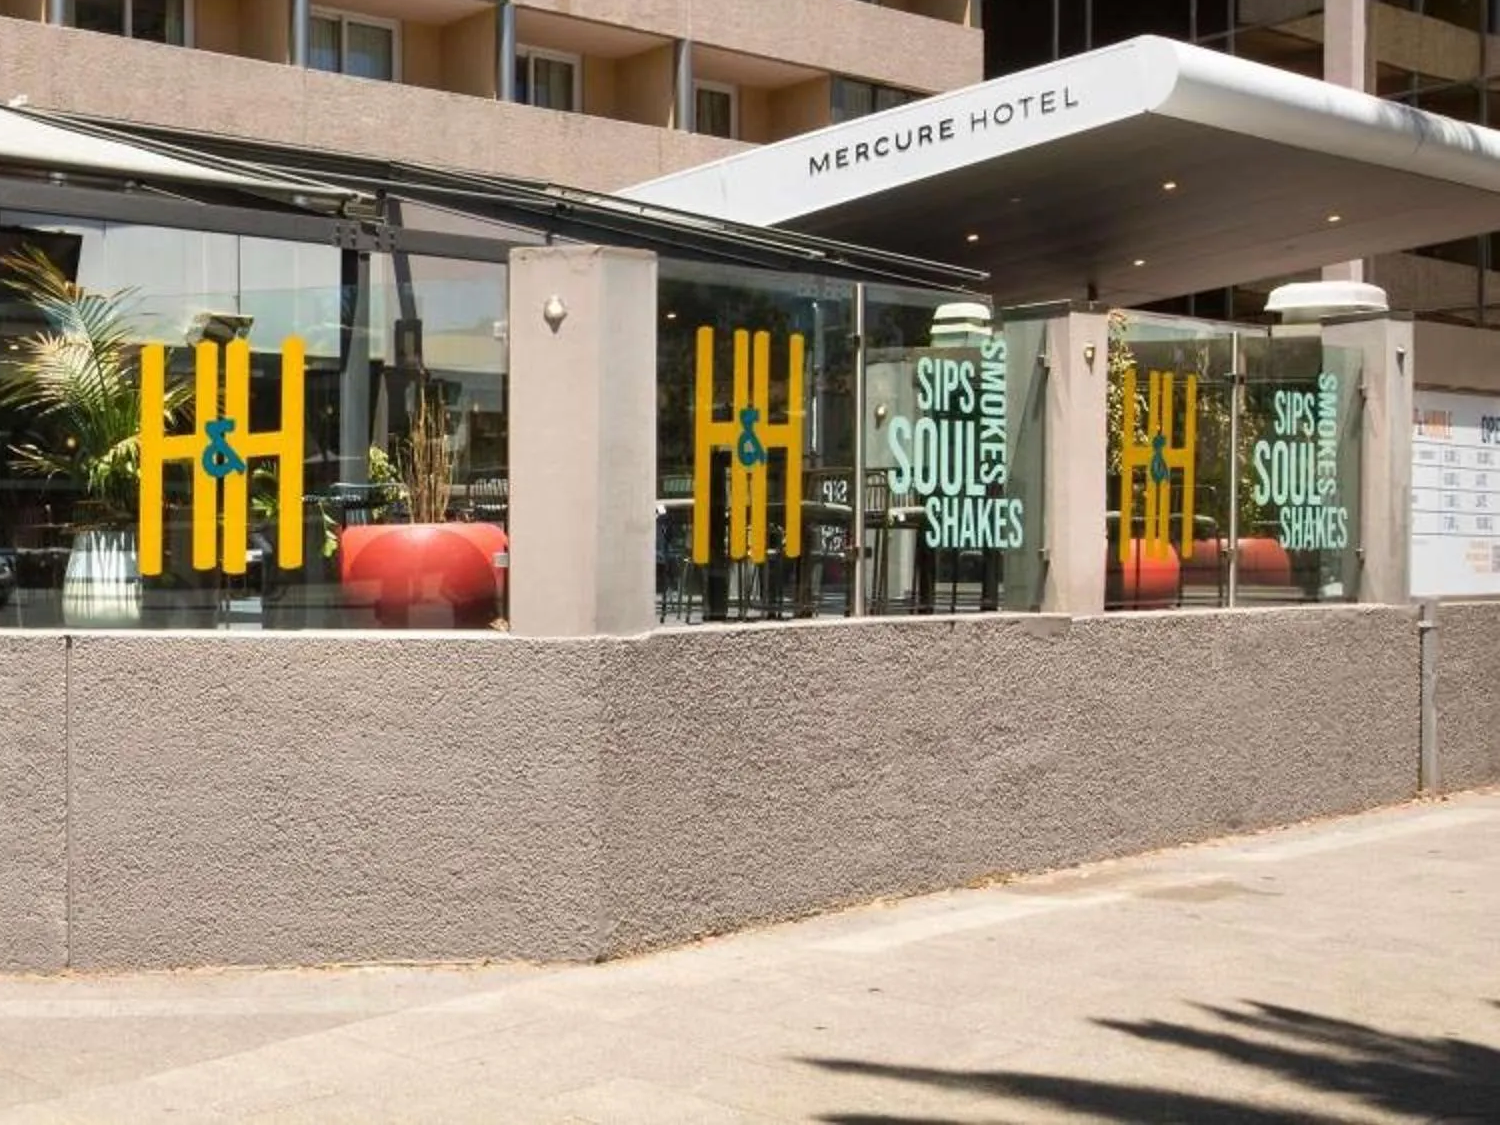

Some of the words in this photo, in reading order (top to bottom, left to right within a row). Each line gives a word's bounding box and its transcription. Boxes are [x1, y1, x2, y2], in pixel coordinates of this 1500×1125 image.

[809, 119, 956, 176] MERCURE
[970, 86, 1079, 133] HOTEL
[917, 356, 975, 414] SIPS
[980, 338, 1007, 485] SMOKES
[1274, 390, 1315, 437] SIPS
[887, 415, 986, 496] SOUL
[1317, 372, 1338, 497] SMOKES
[1254, 440, 1322, 507] SOUL
[925, 496, 1024, 549] SHAKES
[1280, 506, 1349, 551] SHAKES
